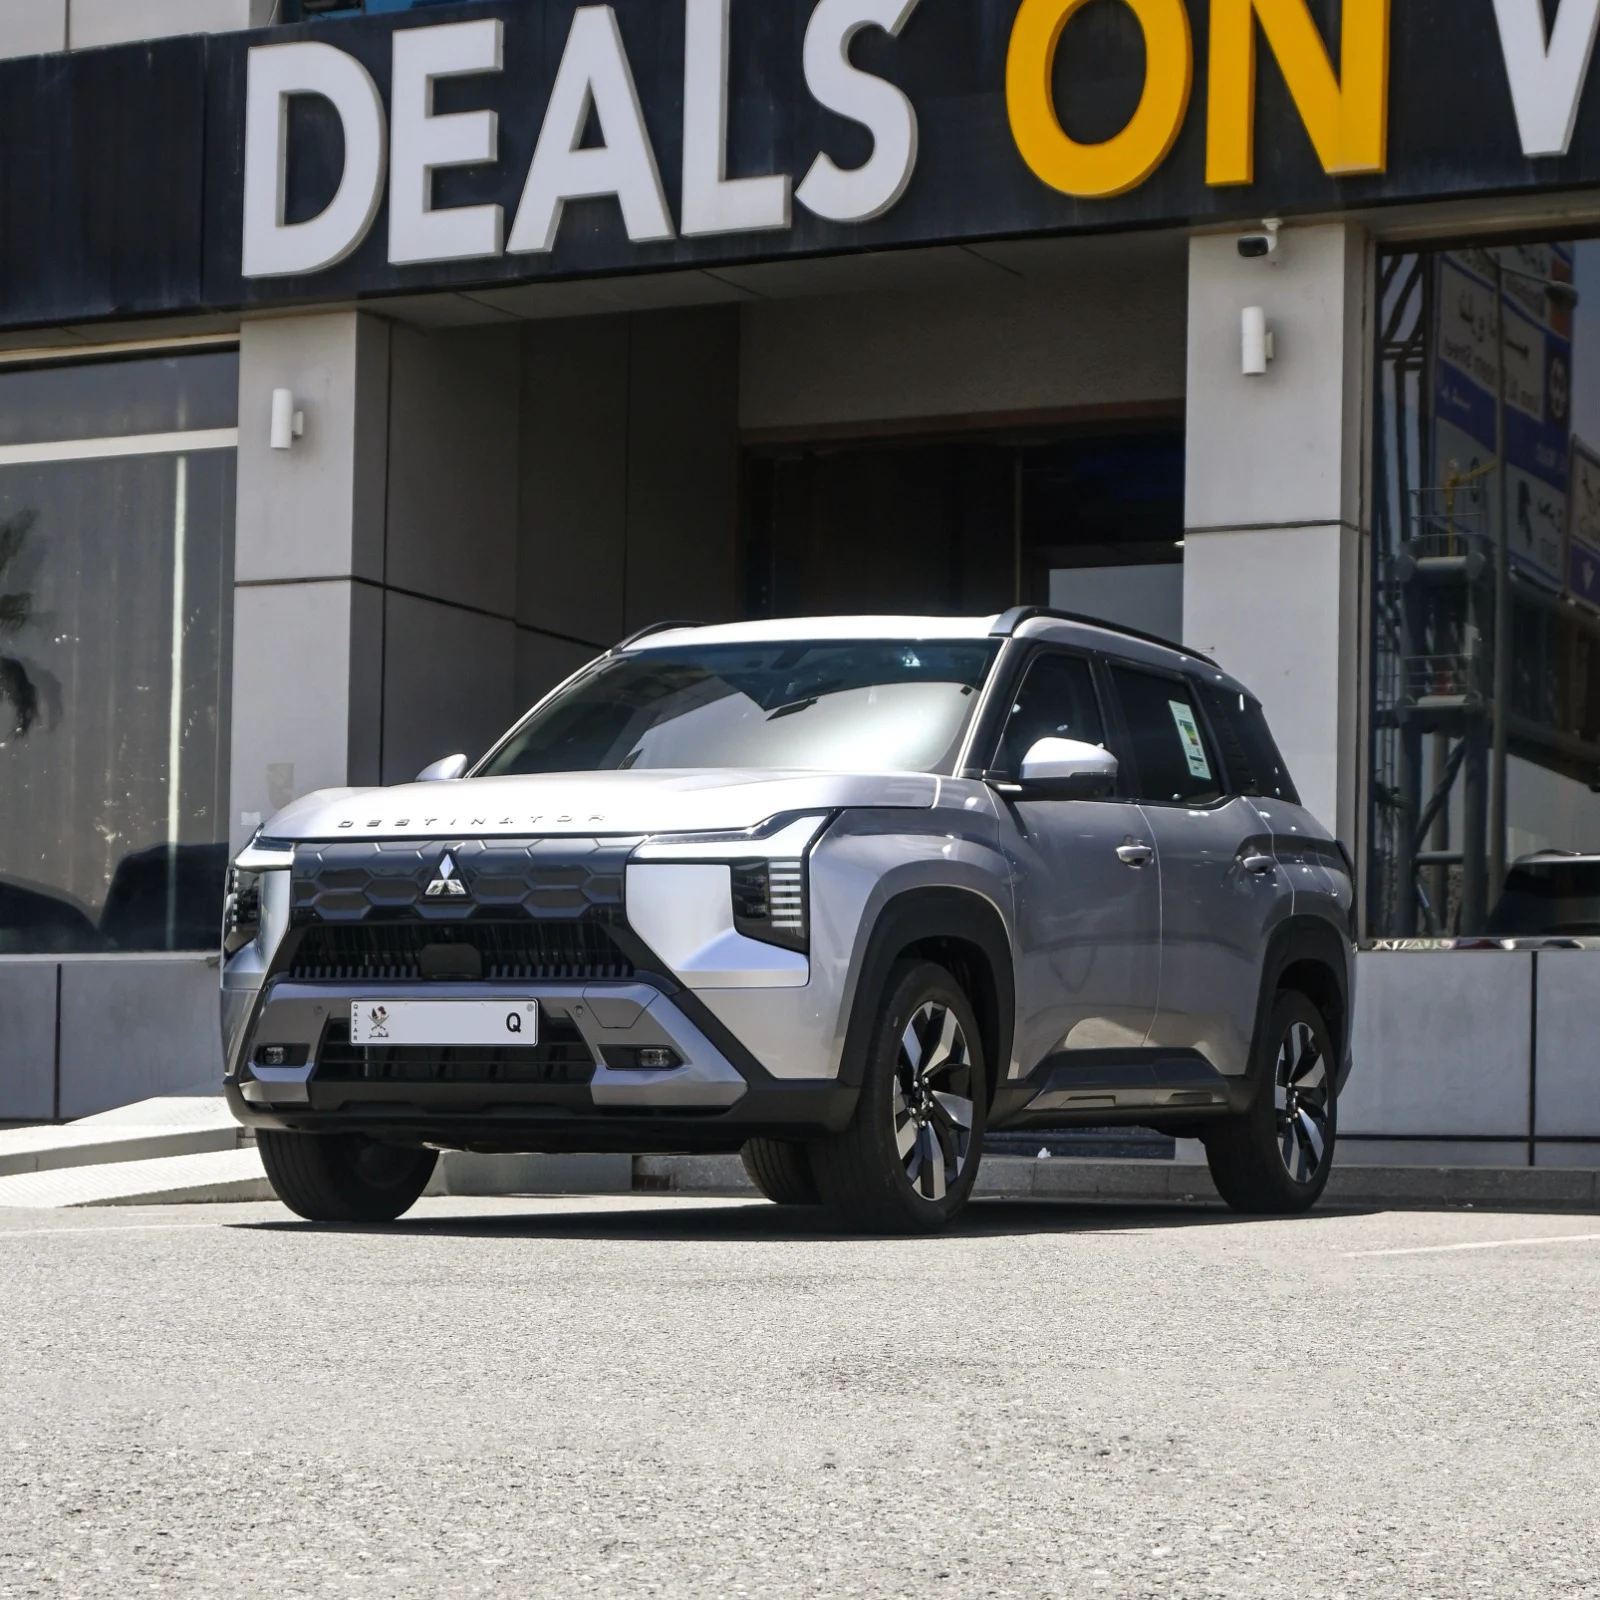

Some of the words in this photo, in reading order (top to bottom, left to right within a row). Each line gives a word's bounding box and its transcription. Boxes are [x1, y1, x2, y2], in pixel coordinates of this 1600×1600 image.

[242, 0, 918, 279] DEALS
[1005, 0, 1391, 199] ON
[337, 814, 606, 829] DESTINATOR
[506, 1012, 521, 1033] Q
